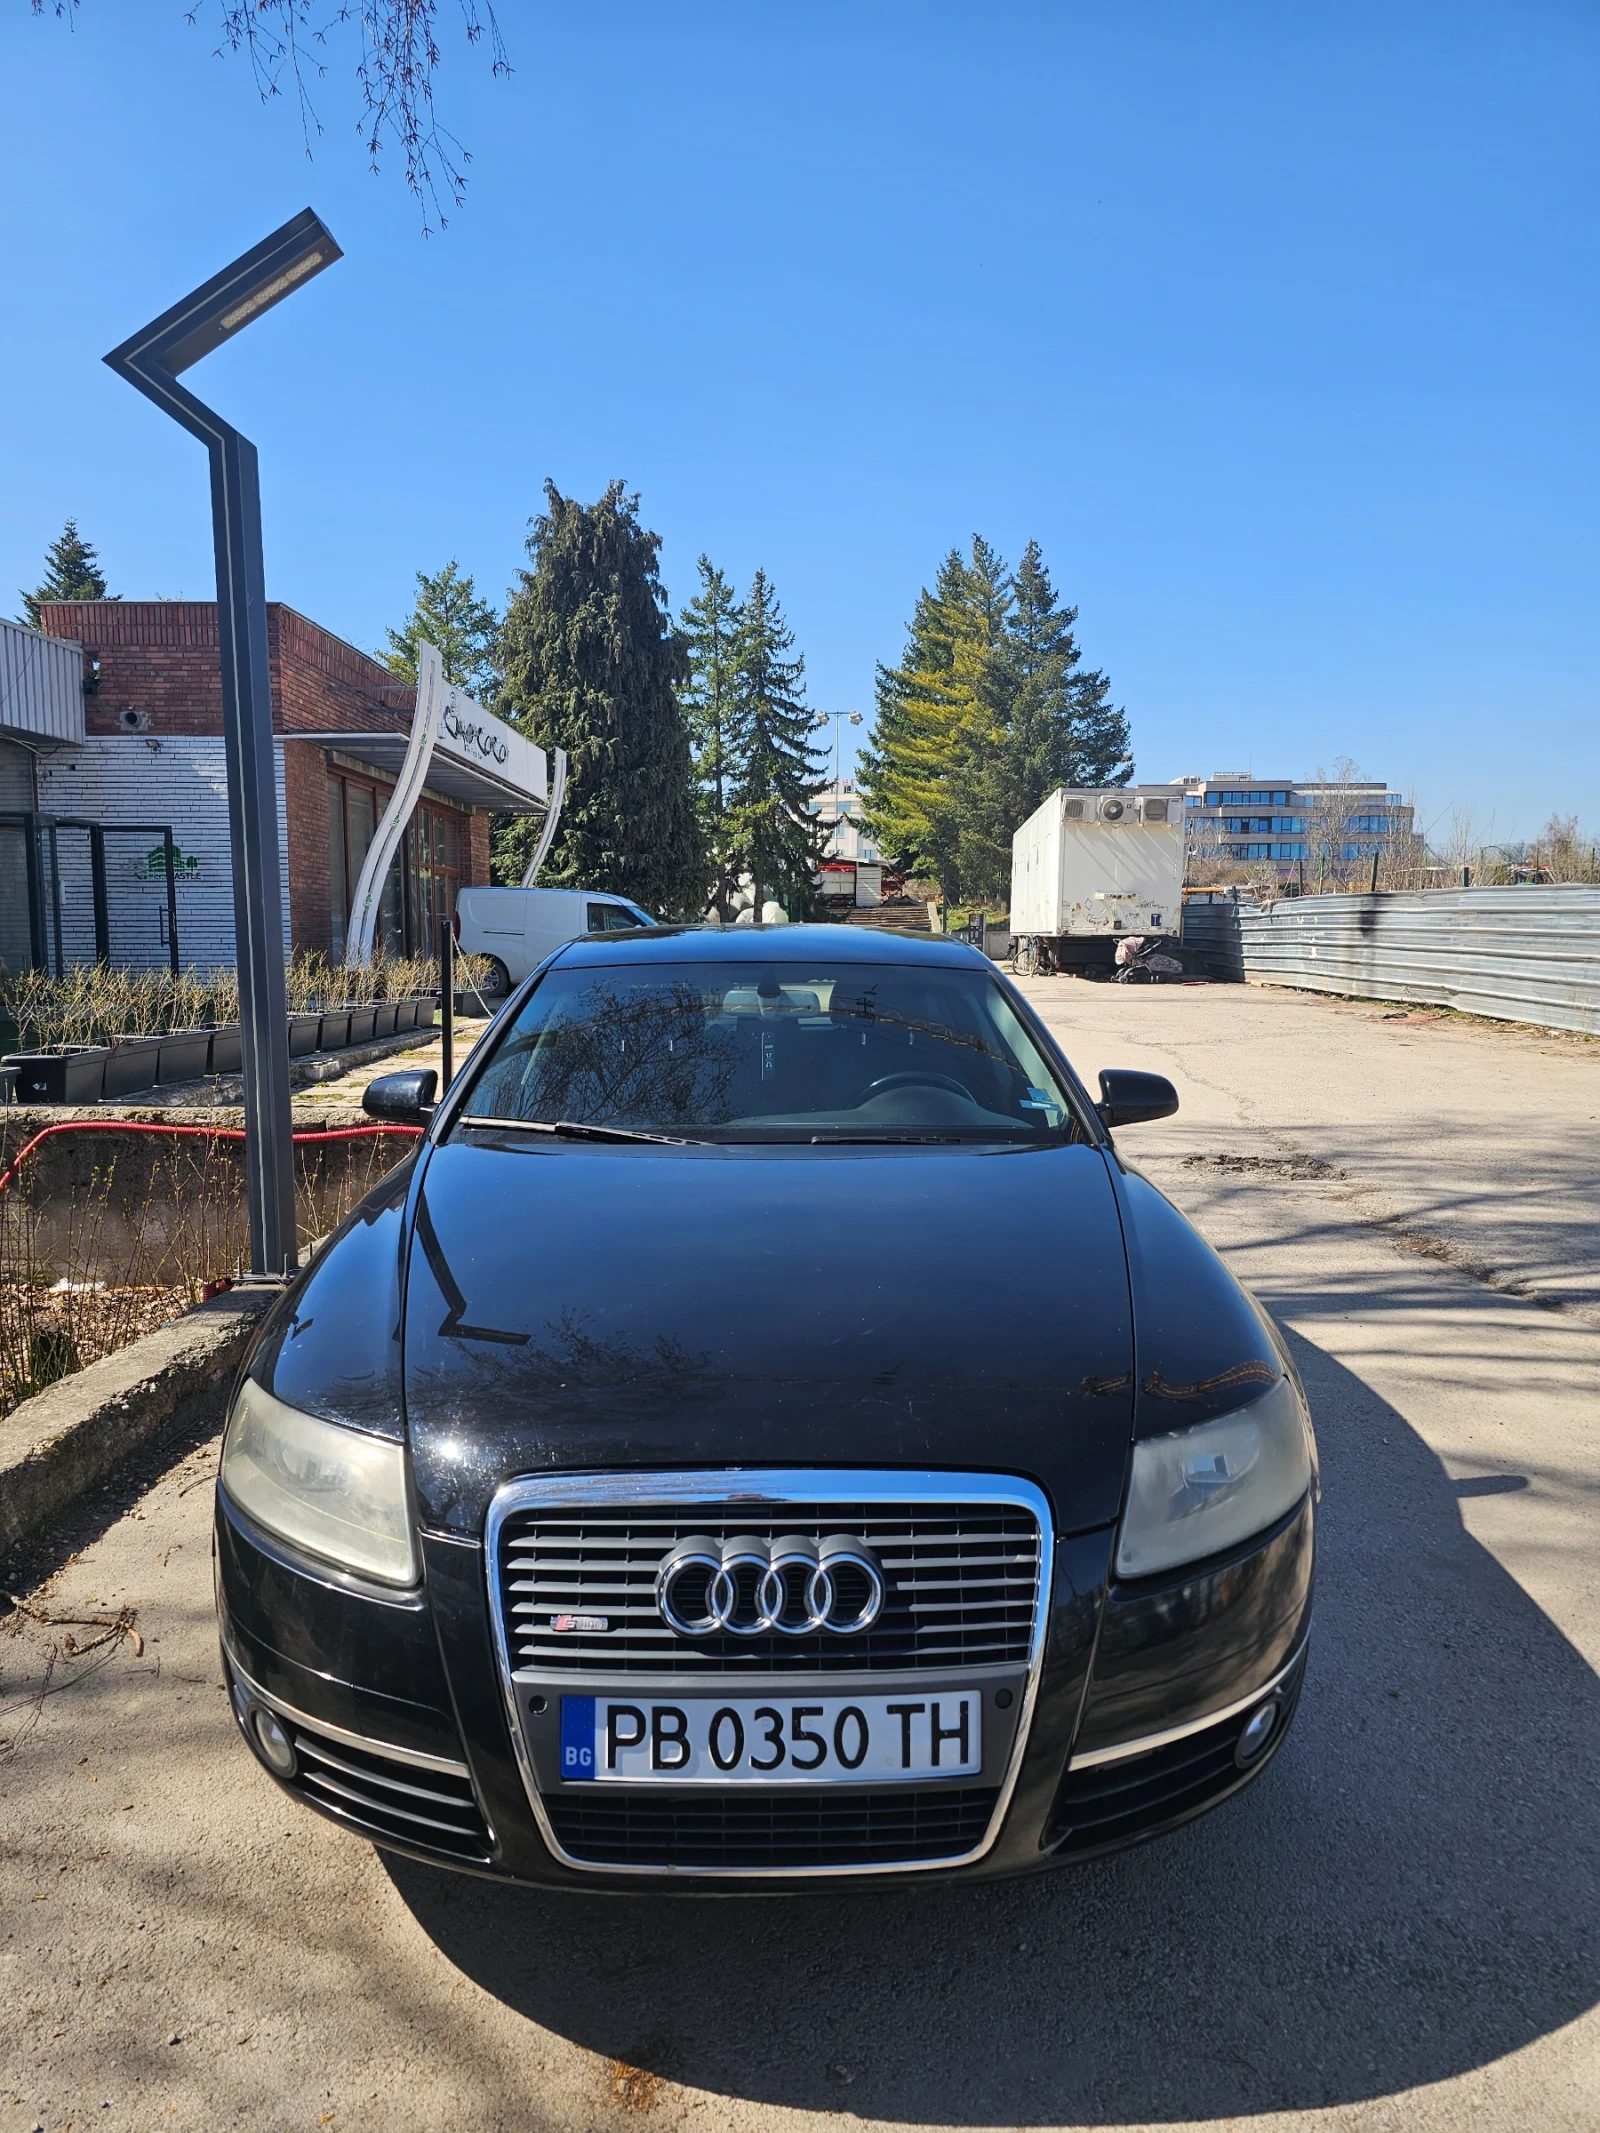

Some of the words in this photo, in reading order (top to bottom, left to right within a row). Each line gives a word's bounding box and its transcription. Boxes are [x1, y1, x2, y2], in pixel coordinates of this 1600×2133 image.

[581, 1618, 603, 1629] line
[606, 1704, 692, 1770] PB
[708, 1706, 870, 1771] 0350
[886, 1700, 970, 1768] TH
[565, 1746, 592, 1767] BG
